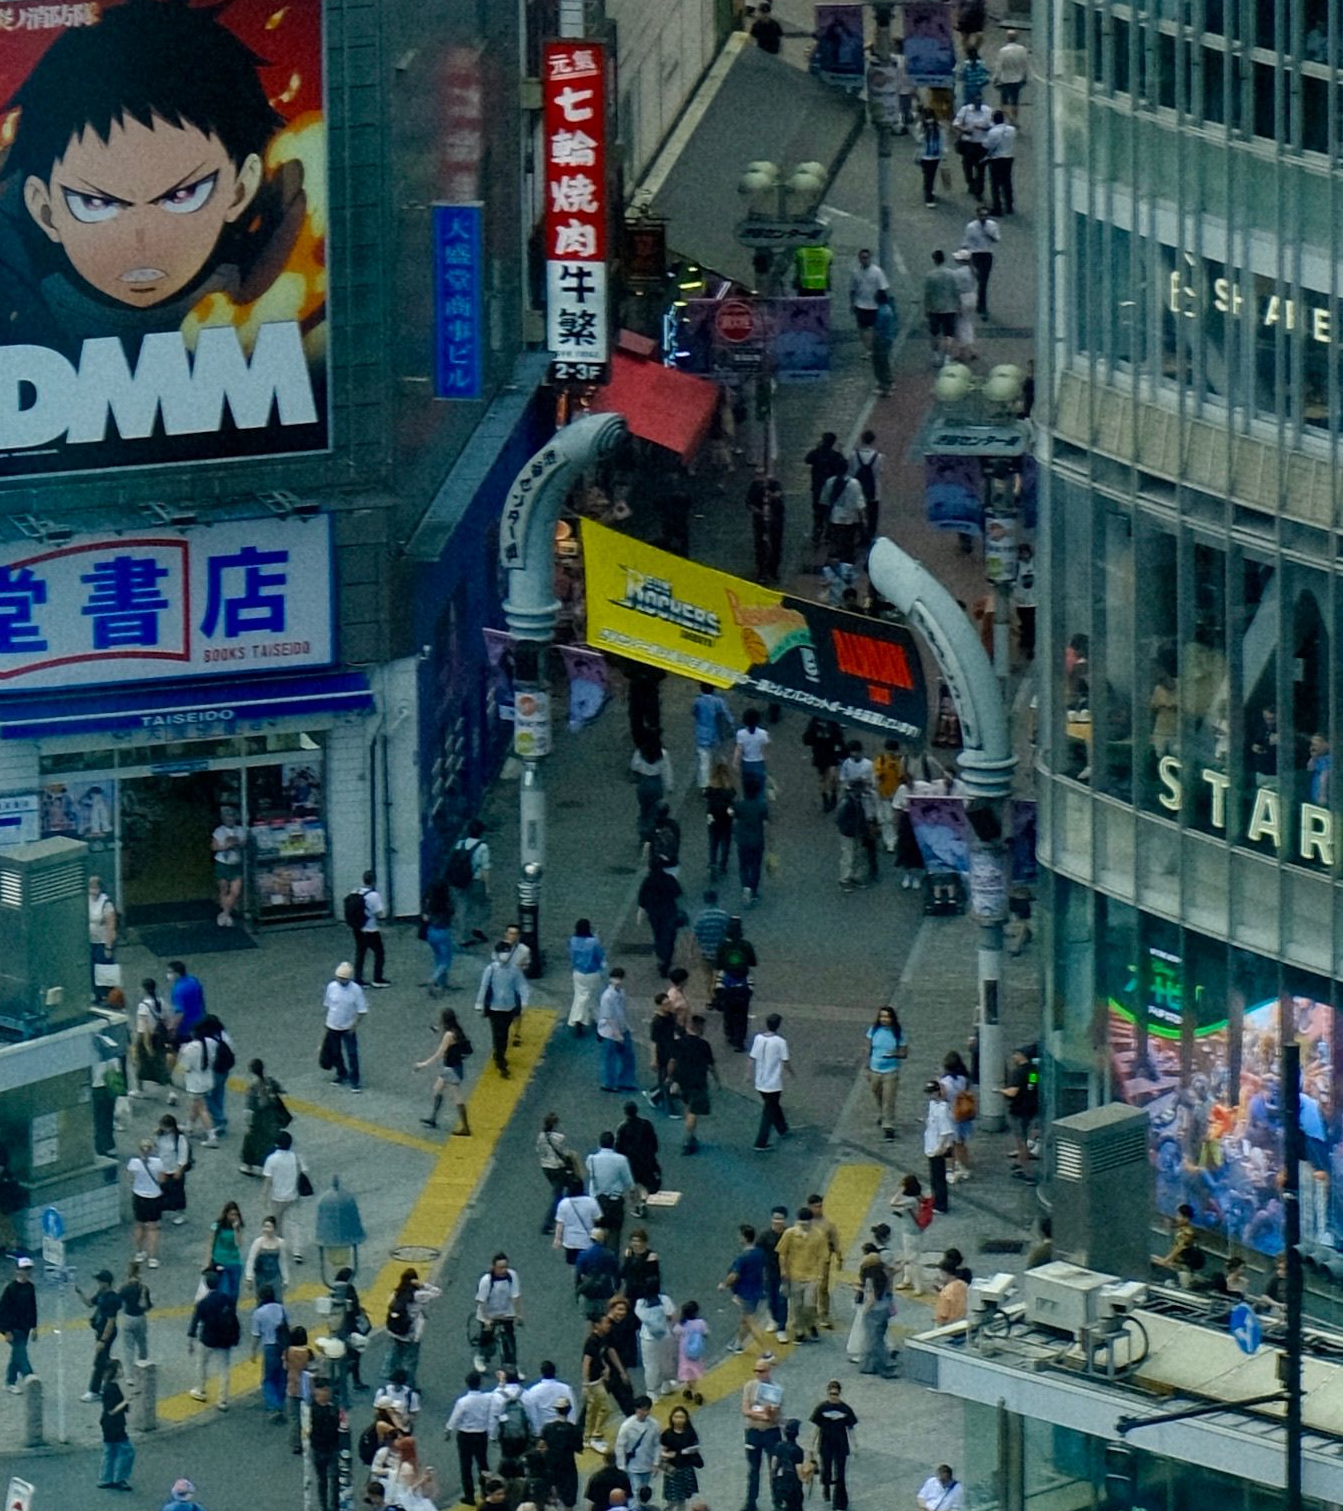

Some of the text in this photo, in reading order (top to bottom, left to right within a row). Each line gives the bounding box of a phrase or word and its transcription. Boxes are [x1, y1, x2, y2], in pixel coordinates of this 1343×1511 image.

[551, 86, 599, 258] 七輪焼肉
[444, 219, 472, 386] 大盛堂商事ビル
[558, 264, 597, 346] 牛繁
[203, 641, 311, 664] BOOKS TAISEIDO
[141, 708, 235, 727] TAISEIDO
[1159, 756, 1334, 865] STAR
